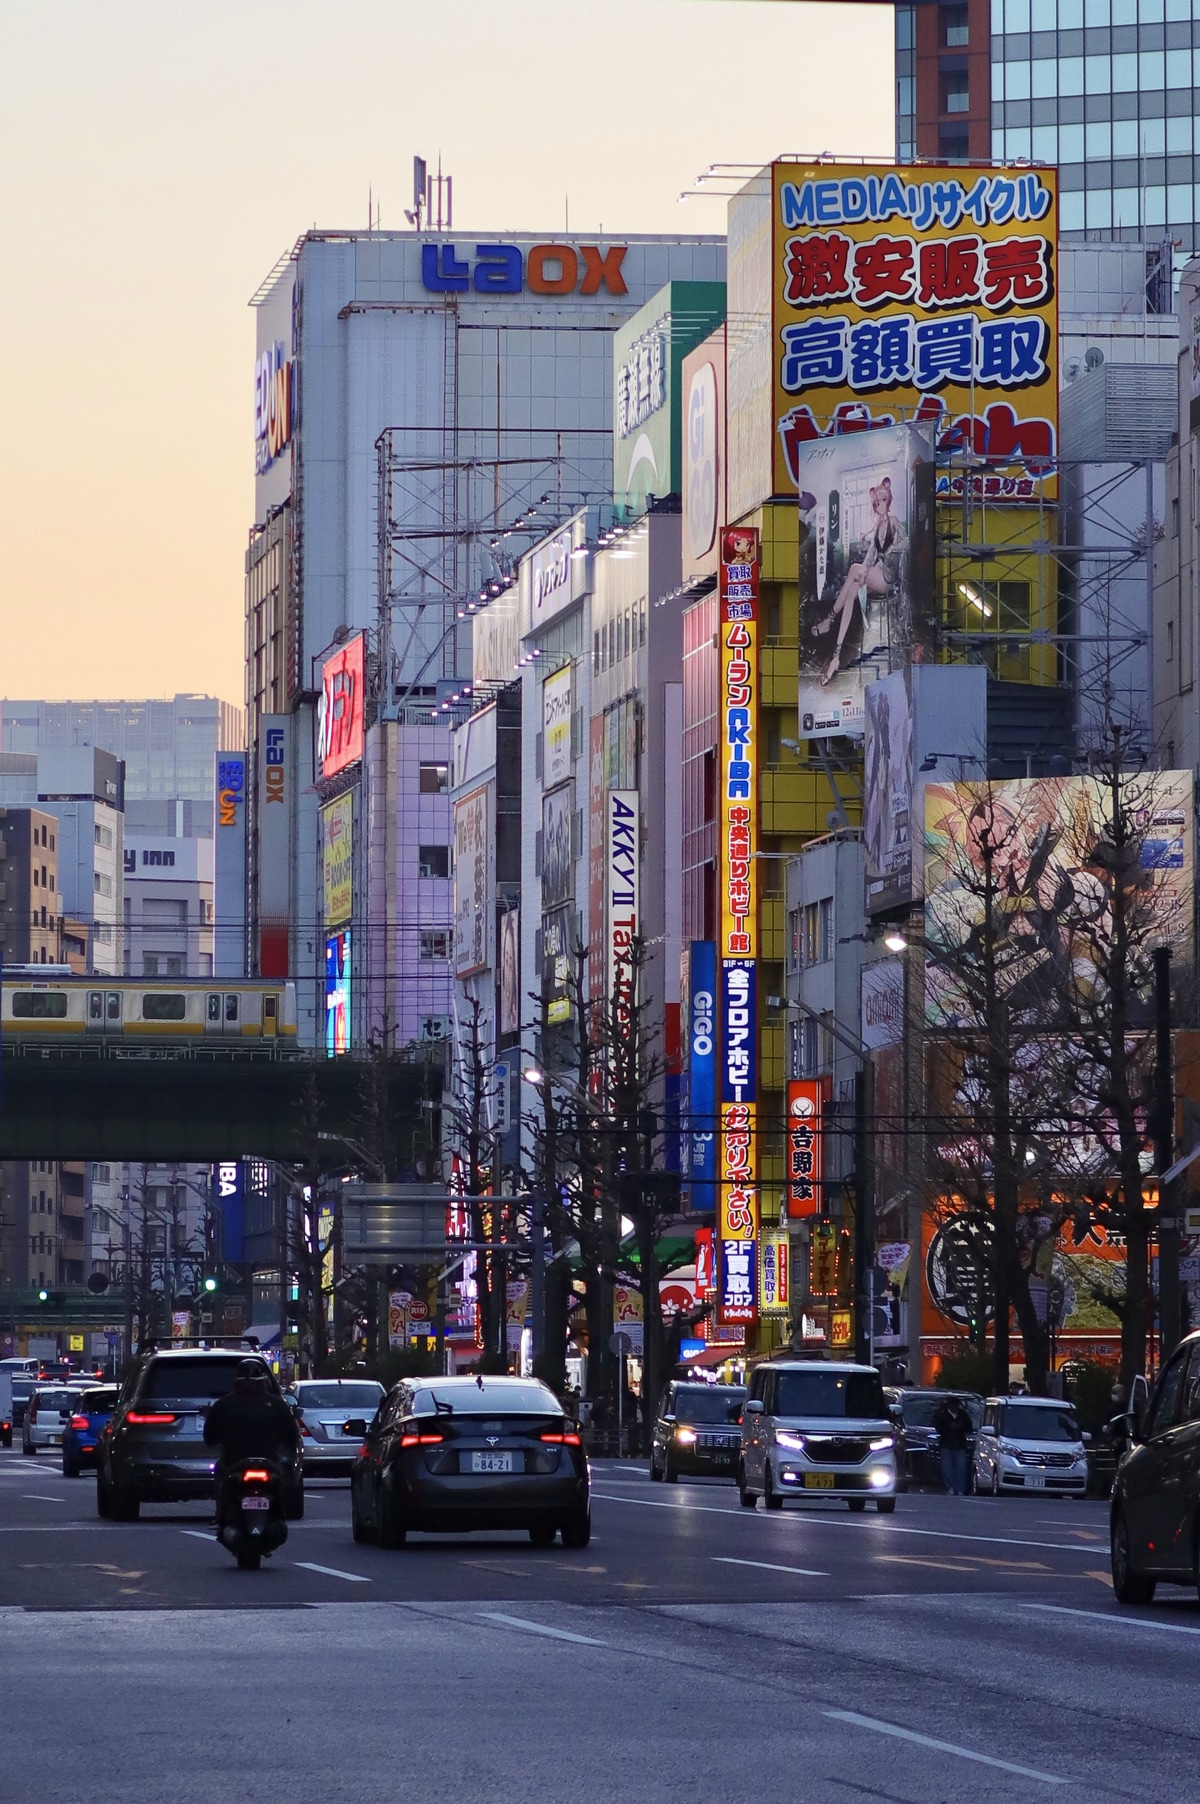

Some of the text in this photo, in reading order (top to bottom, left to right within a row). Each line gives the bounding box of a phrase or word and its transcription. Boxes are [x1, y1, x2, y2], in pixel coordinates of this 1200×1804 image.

[781, 173, 1050, 231] MEDIAリサイクル
[785, 233, 1047, 308] 激安販売
[781, 314, 1046, 391] 高額買取
[727, 564, 752, 581] 買取
[727, 583, 752, 598] 販売
[727, 603, 753, 619] 市場
[726, 624, 753, 799] ムーランAKIBA
[142, 850, 175, 866] inn
[612, 796, 635, 888] AKKY
[727, 805, 753, 954] 中央通りホビー館
[726, 968, 751, 1103] 全フロアホビー
[790, 1124, 814, 1200] 吉野家
[724, 1240, 753, 1255] 2F
[726, 1255, 751, 1294] 買取
[724, 1294, 753, 1306] フロア
[481, 1460, 509, 1470] 84-21
